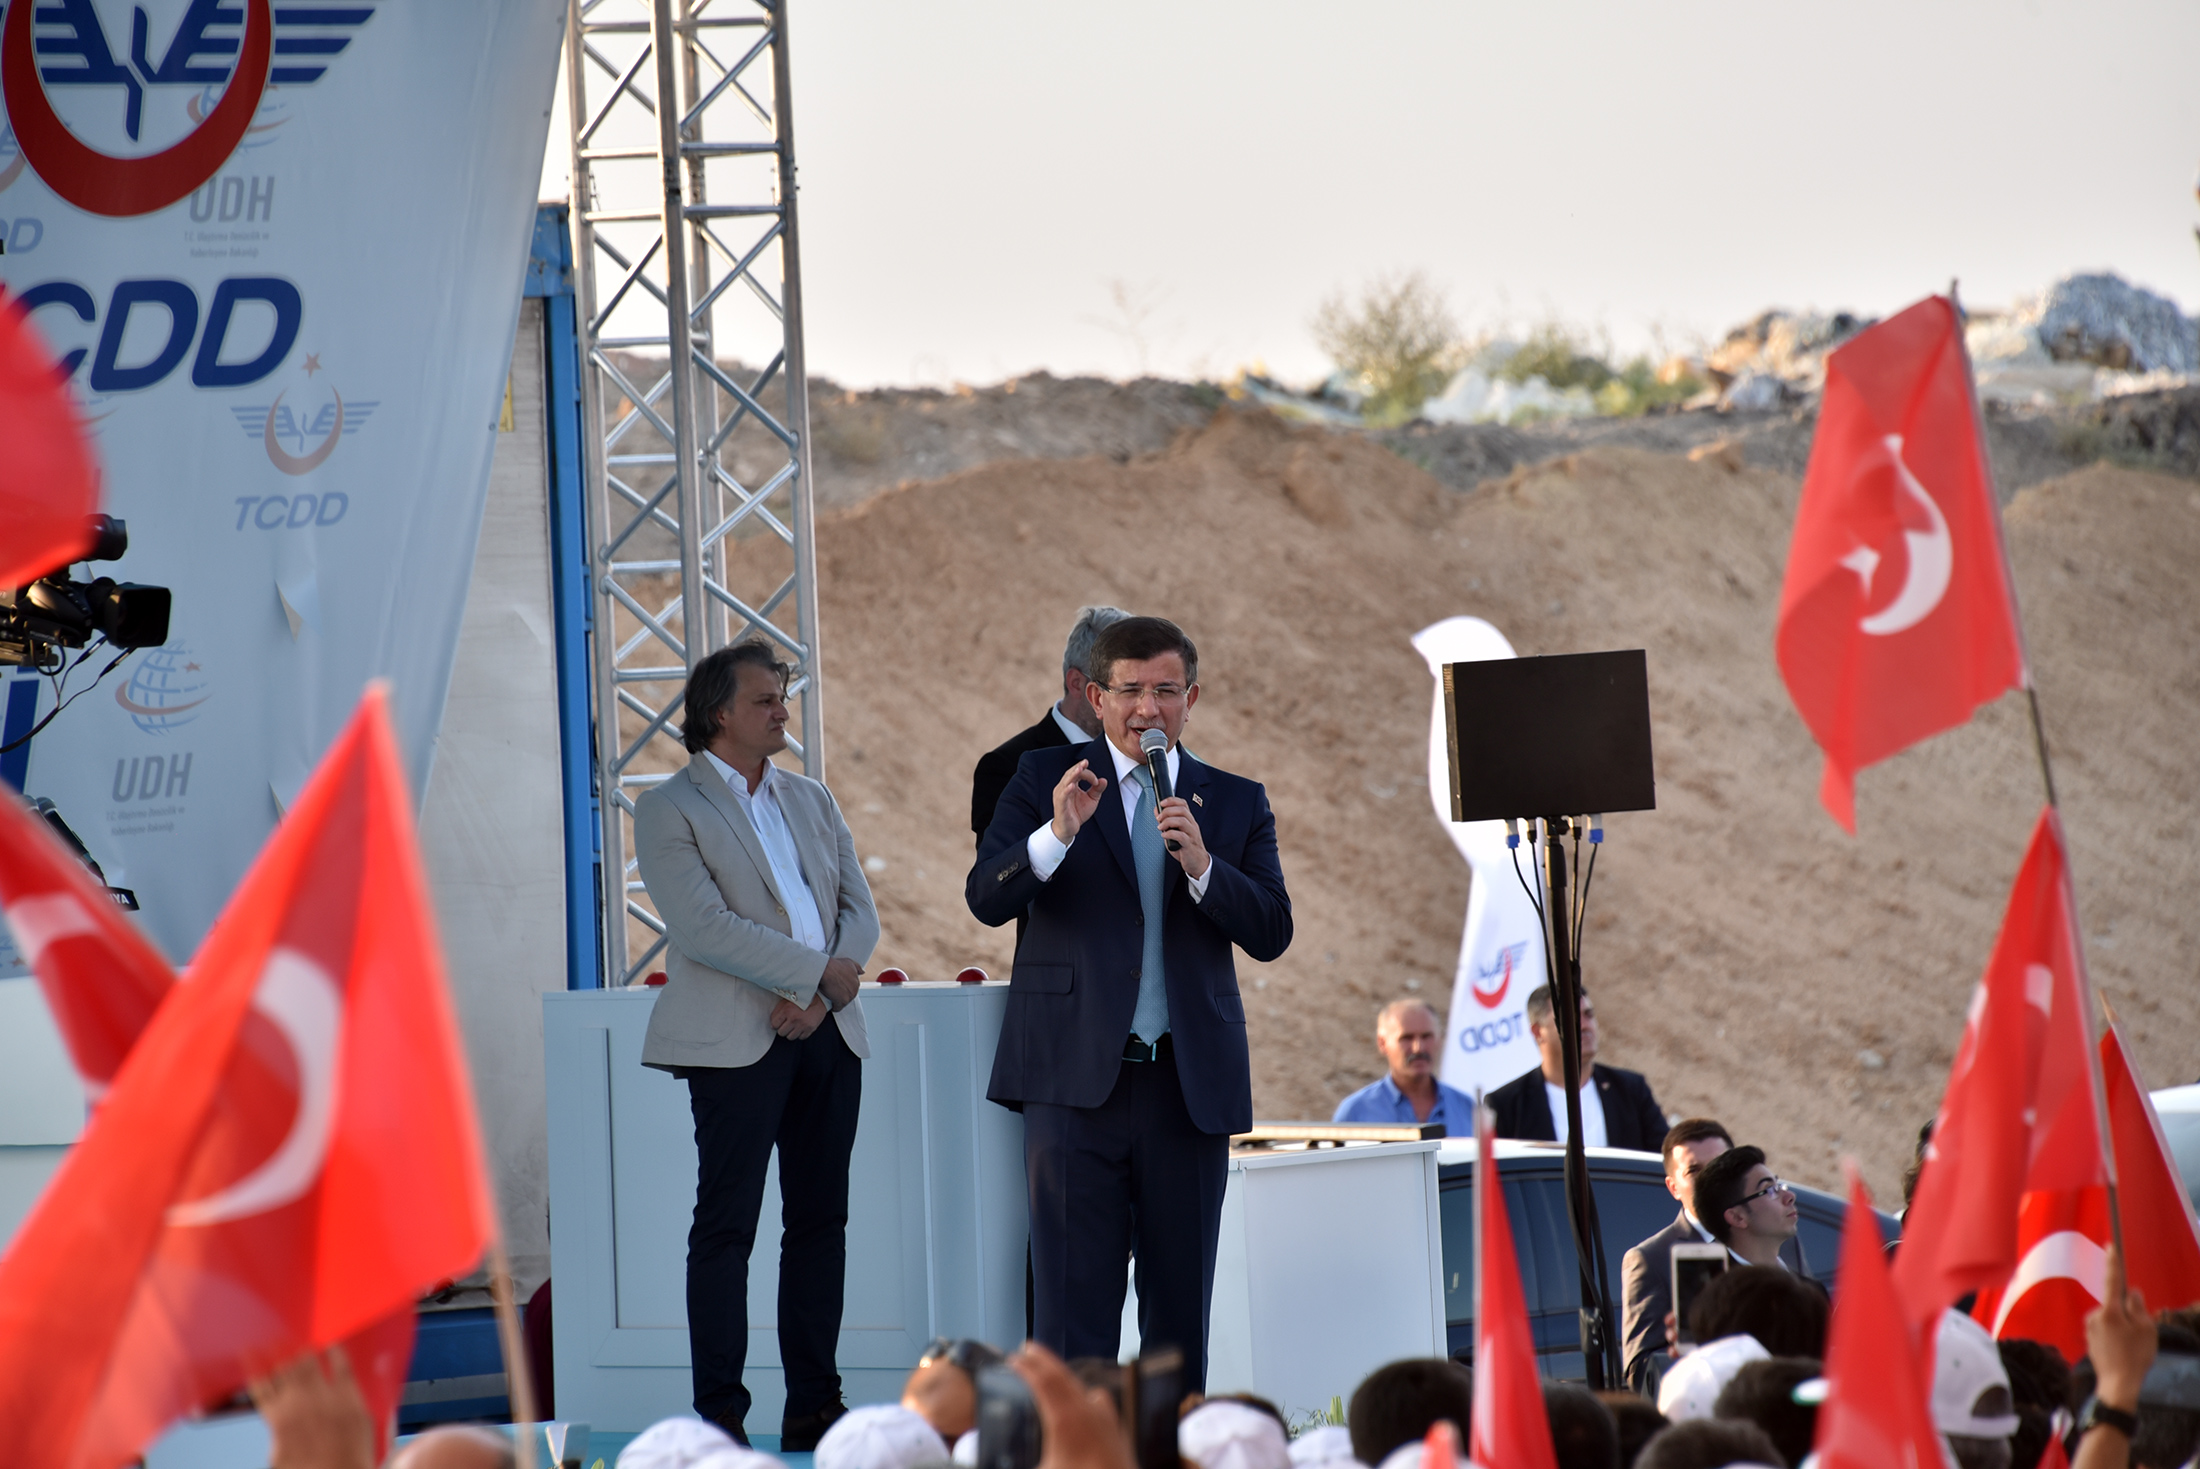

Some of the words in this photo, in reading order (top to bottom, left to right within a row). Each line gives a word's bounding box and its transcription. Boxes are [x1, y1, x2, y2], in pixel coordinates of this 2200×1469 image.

[190, 176, 275, 223] UDH
[0, 277, 302, 391] CDD
[235, 491, 349, 531] TCDD
[112, 752, 193, 803] UDH
